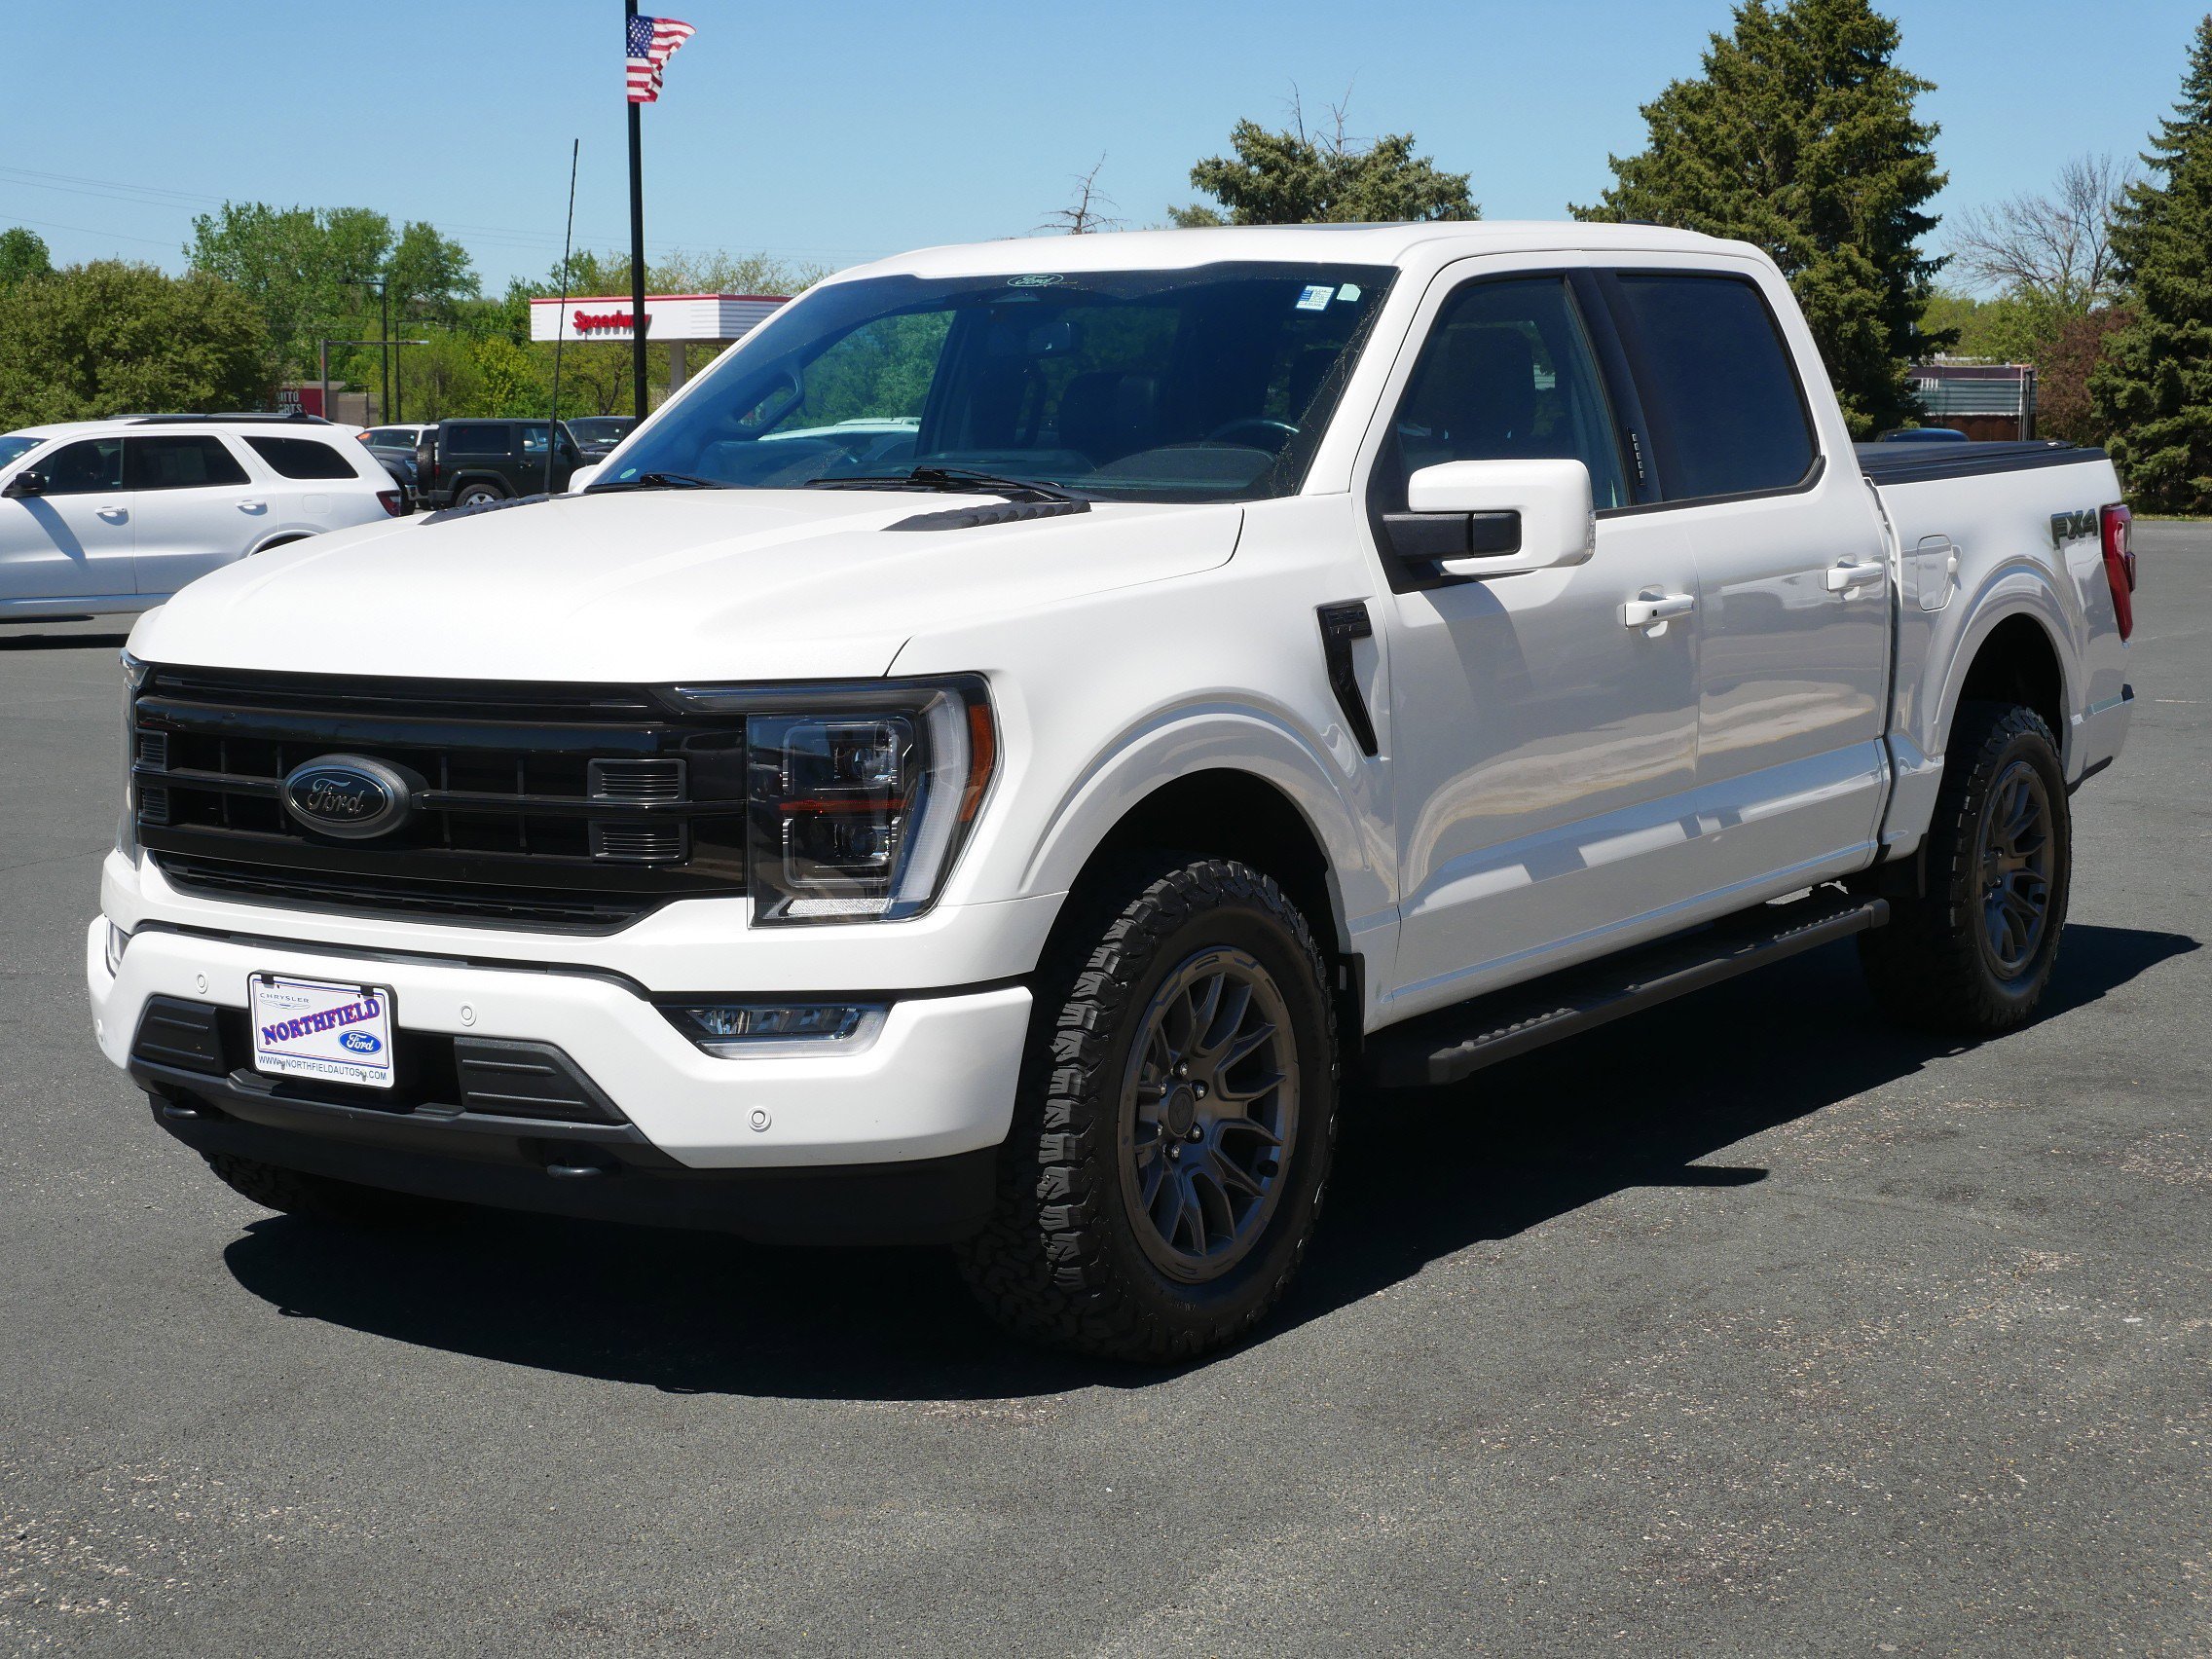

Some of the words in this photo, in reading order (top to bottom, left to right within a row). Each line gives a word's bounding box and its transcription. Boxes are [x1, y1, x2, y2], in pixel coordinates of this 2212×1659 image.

[1014, 274, 1055, 285] Ford
[572, 310, 652, 334] Speedwy
[2050, 508, 2099, 551] FX4
[307, 778, 366, 815] Ford
[259, 992, 310, 1004] CHRYSLER
[261, 999, 381, 1046] NORTHFIELD
[346, 1033, 375, 1051] Ford
[258, 1055, 387, 1081] WWWNORTHFIELDAUTOS.COM
